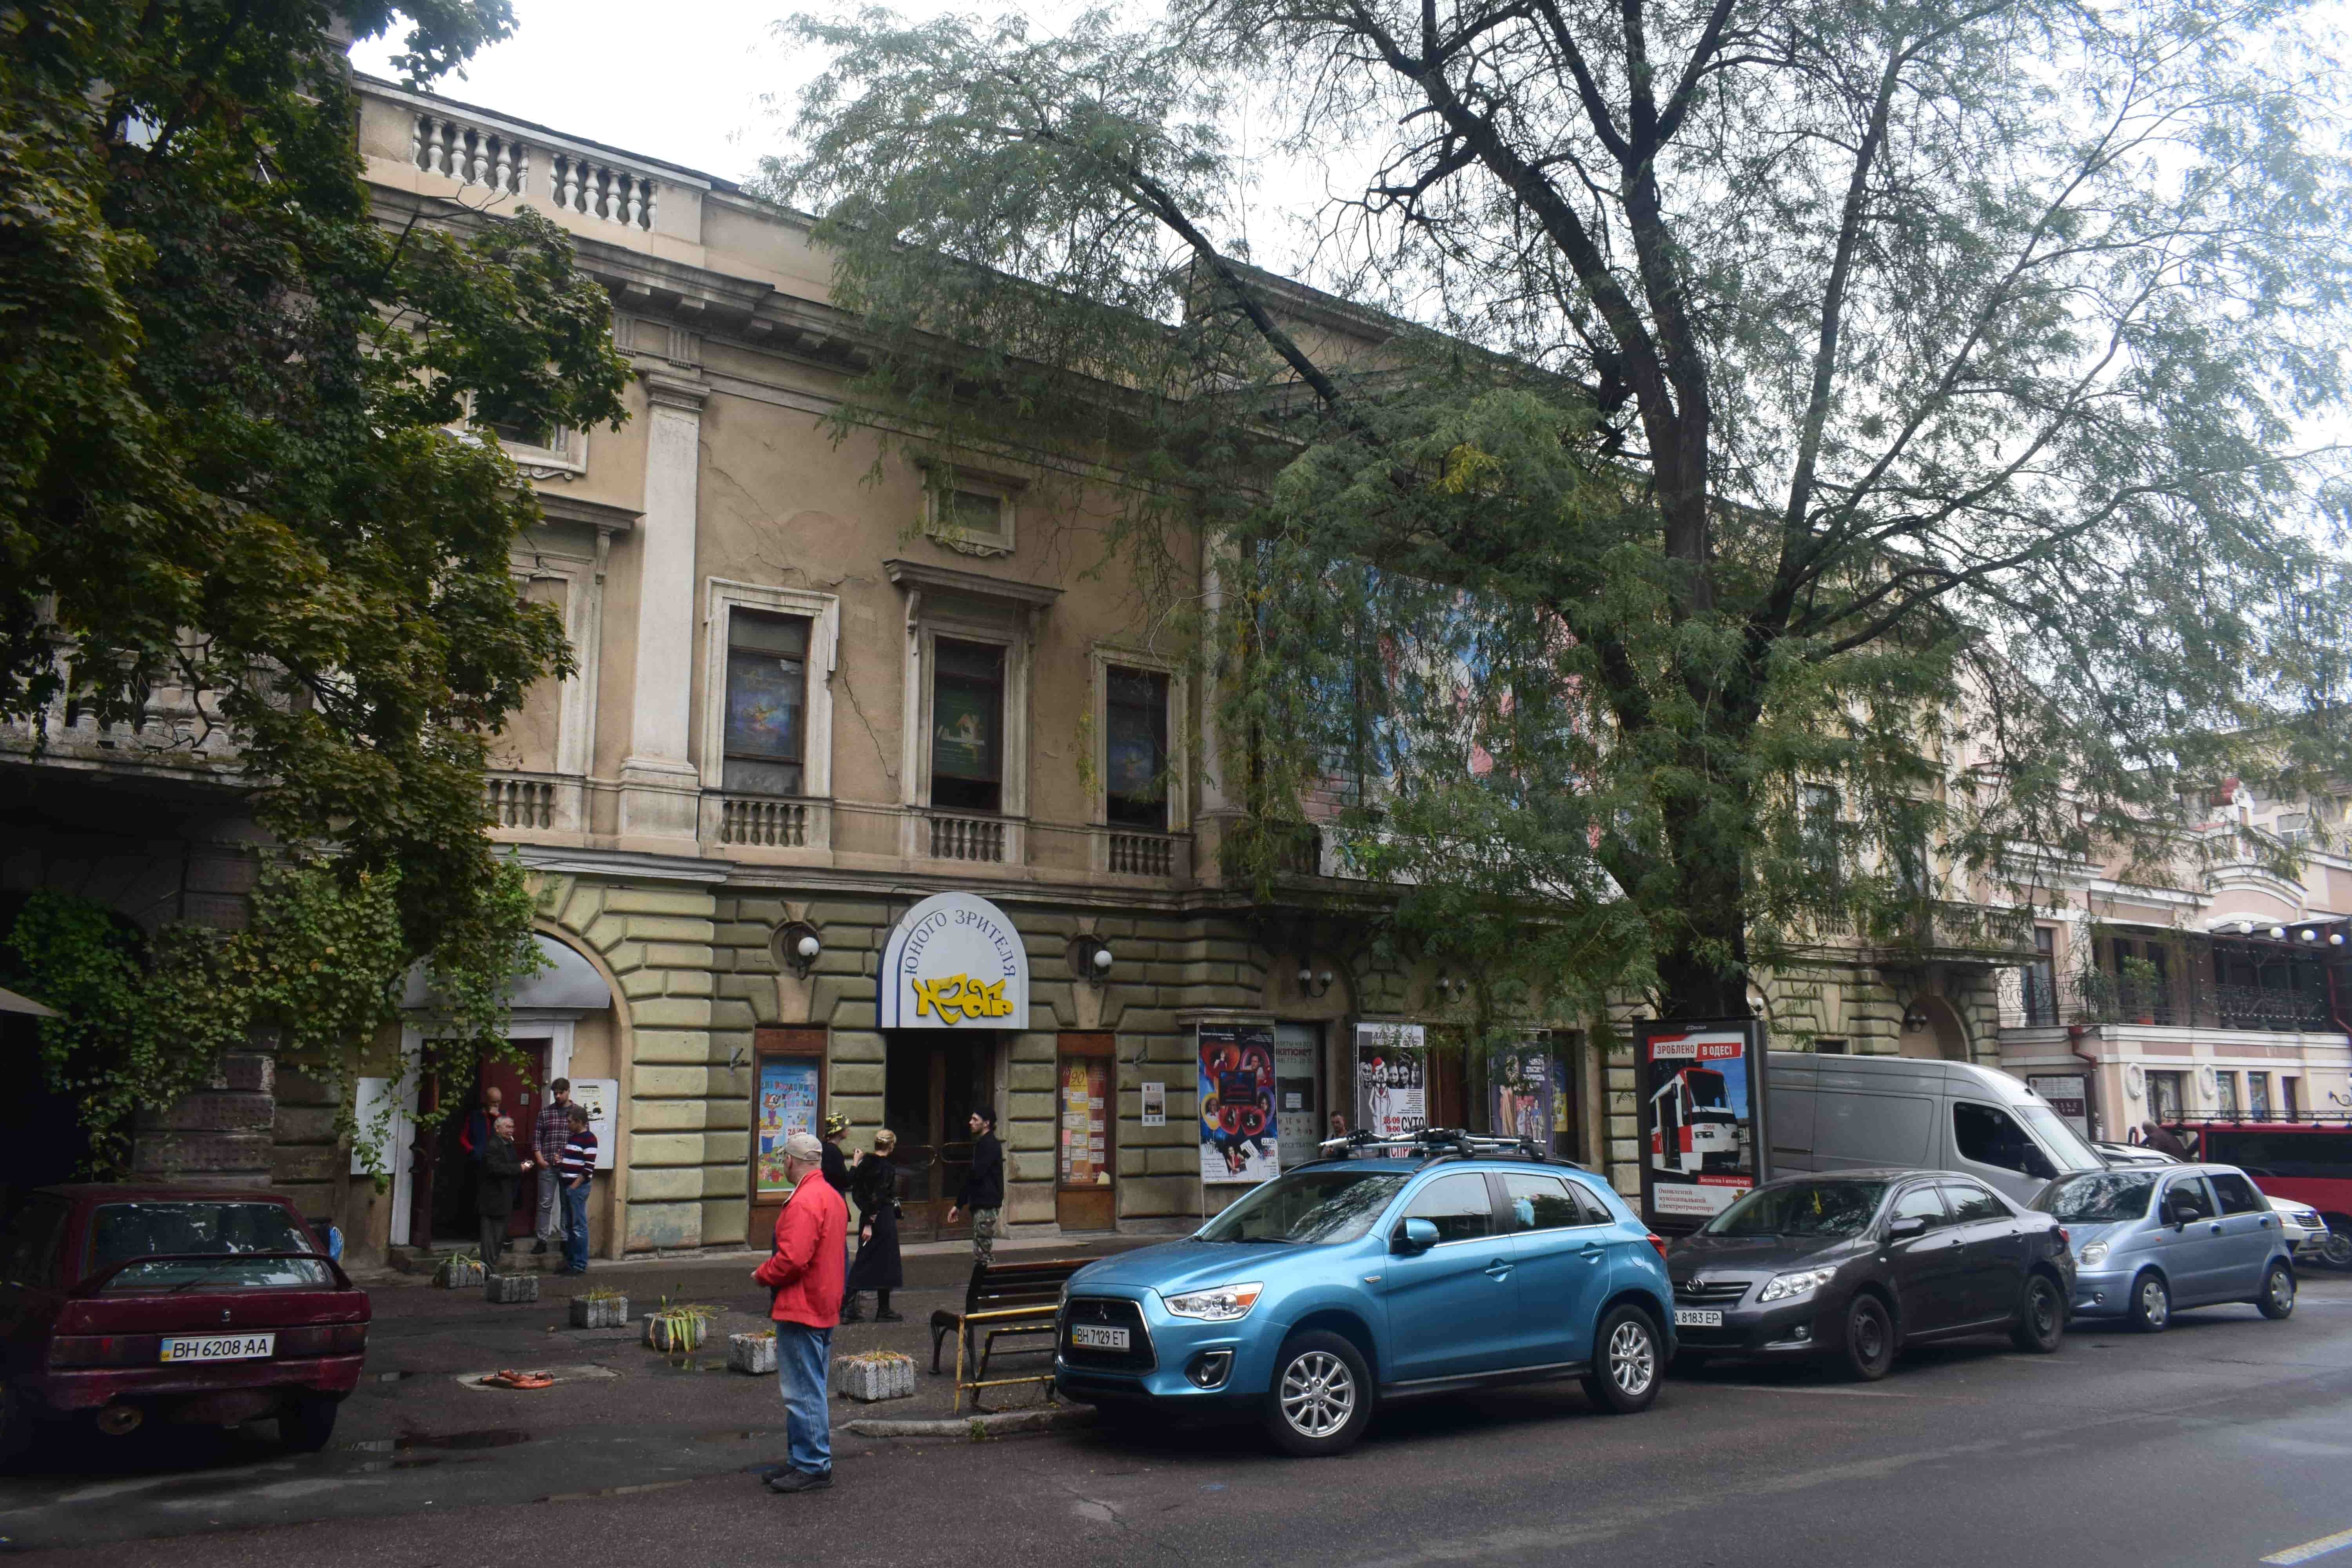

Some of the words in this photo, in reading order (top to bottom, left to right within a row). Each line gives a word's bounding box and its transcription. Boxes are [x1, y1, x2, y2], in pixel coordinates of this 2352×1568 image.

[904, 912, 947, 975] ЮНОГО
[955, 909, 1016, 977] ЗРИТЕЛЯ
[1657, 1044, 1695, 1054] ЗРОБЛЕНО
[1702, 1046, 1707, 1055] В
[1710, 1045, 1732, 1057] ОДЕСІ
[1658, 1187, 1693, 1196] Оновлений
[1659, 1203, 1714, 1212] електротранспорт
[1682, 1312, 1703, 1323] 8183
[1706, 1313, 1719, 1324] EP
[1077, 1328, 1089, 1343] BH
[1091, 1329, 1110, 1345] 7129
[1113, 1331, 1125, 1346] ET
[173, 1341, 198, 1358] BH
[203, 1340, 241, 1357] 6208
[245, 1338, 267, 1354] AA
